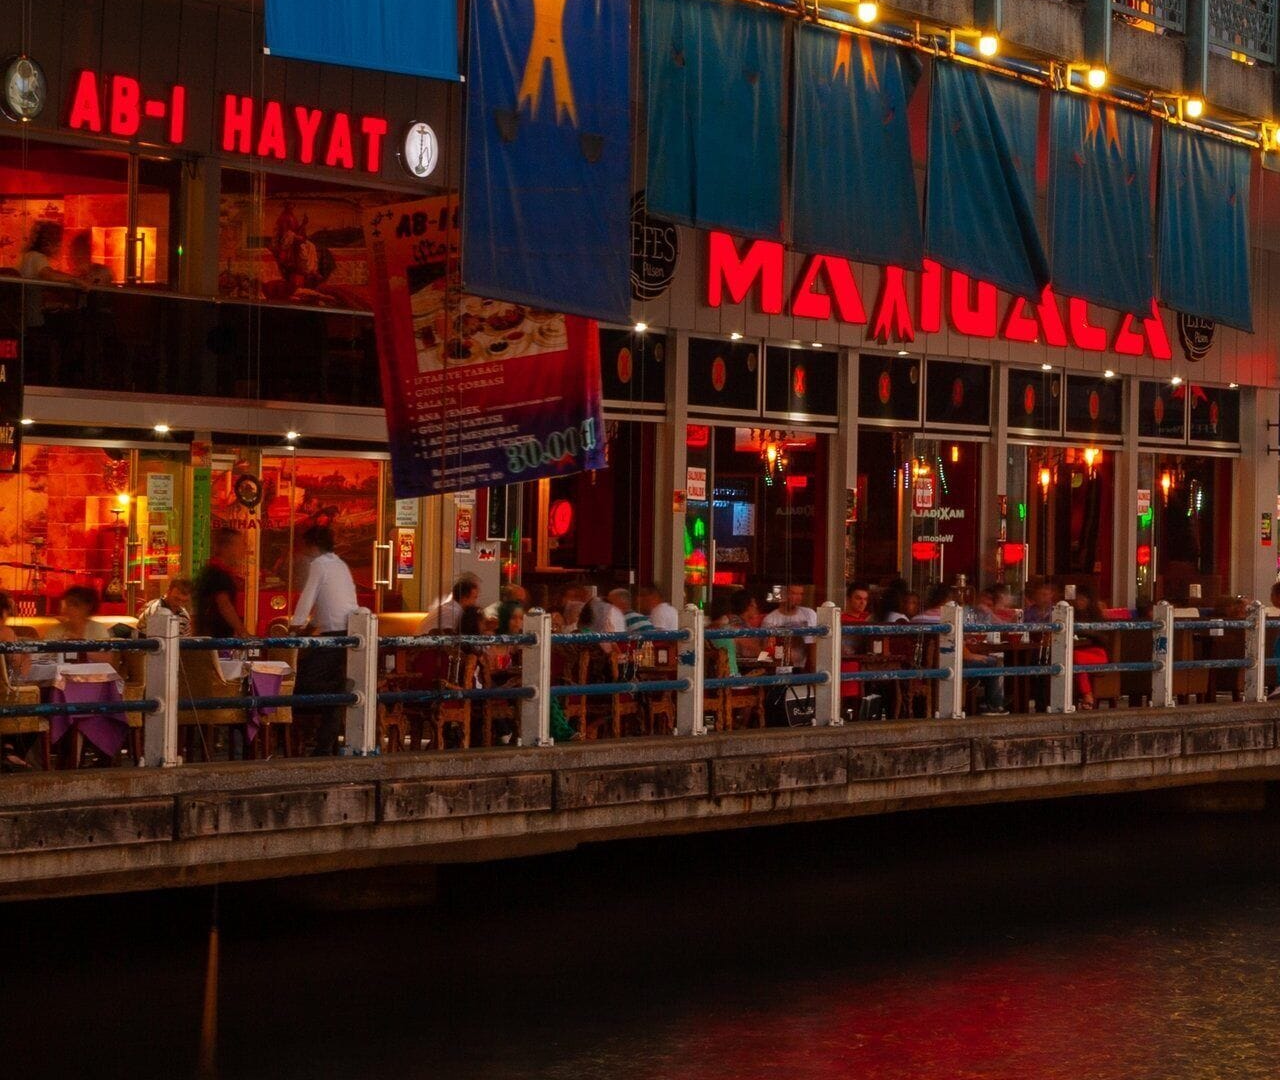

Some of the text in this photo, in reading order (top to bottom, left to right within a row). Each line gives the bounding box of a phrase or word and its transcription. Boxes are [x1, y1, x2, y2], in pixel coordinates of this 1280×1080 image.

[69, 70, 388, 172] AB-I HAYAT
[629, 221, 675, 262] EFES
[643, 261, 665, 278] Pilsen
